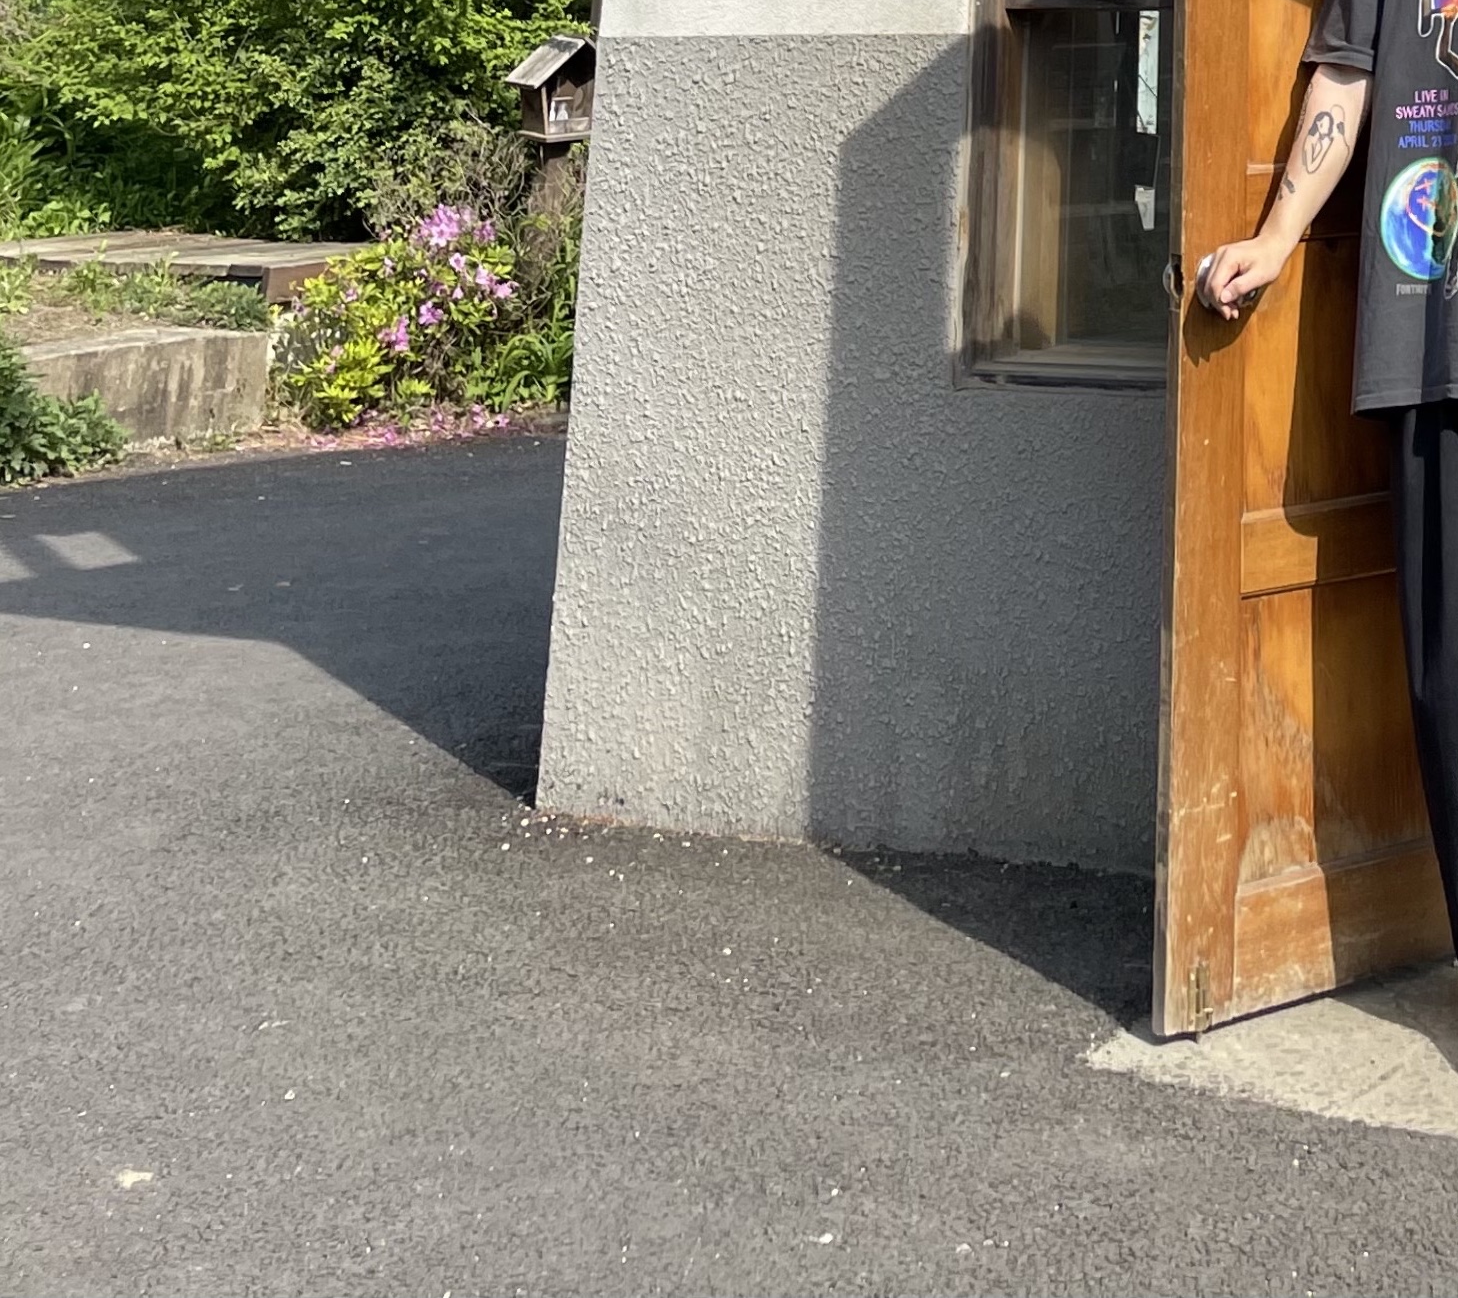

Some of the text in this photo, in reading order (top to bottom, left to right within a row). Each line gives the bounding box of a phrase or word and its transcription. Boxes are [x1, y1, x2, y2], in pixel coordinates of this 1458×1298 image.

[1414, 90, 1438, 104] LIVE
[1395, 105, 1437, 119] SWEATY
[1398, 136, 1430, 149] APRIL
